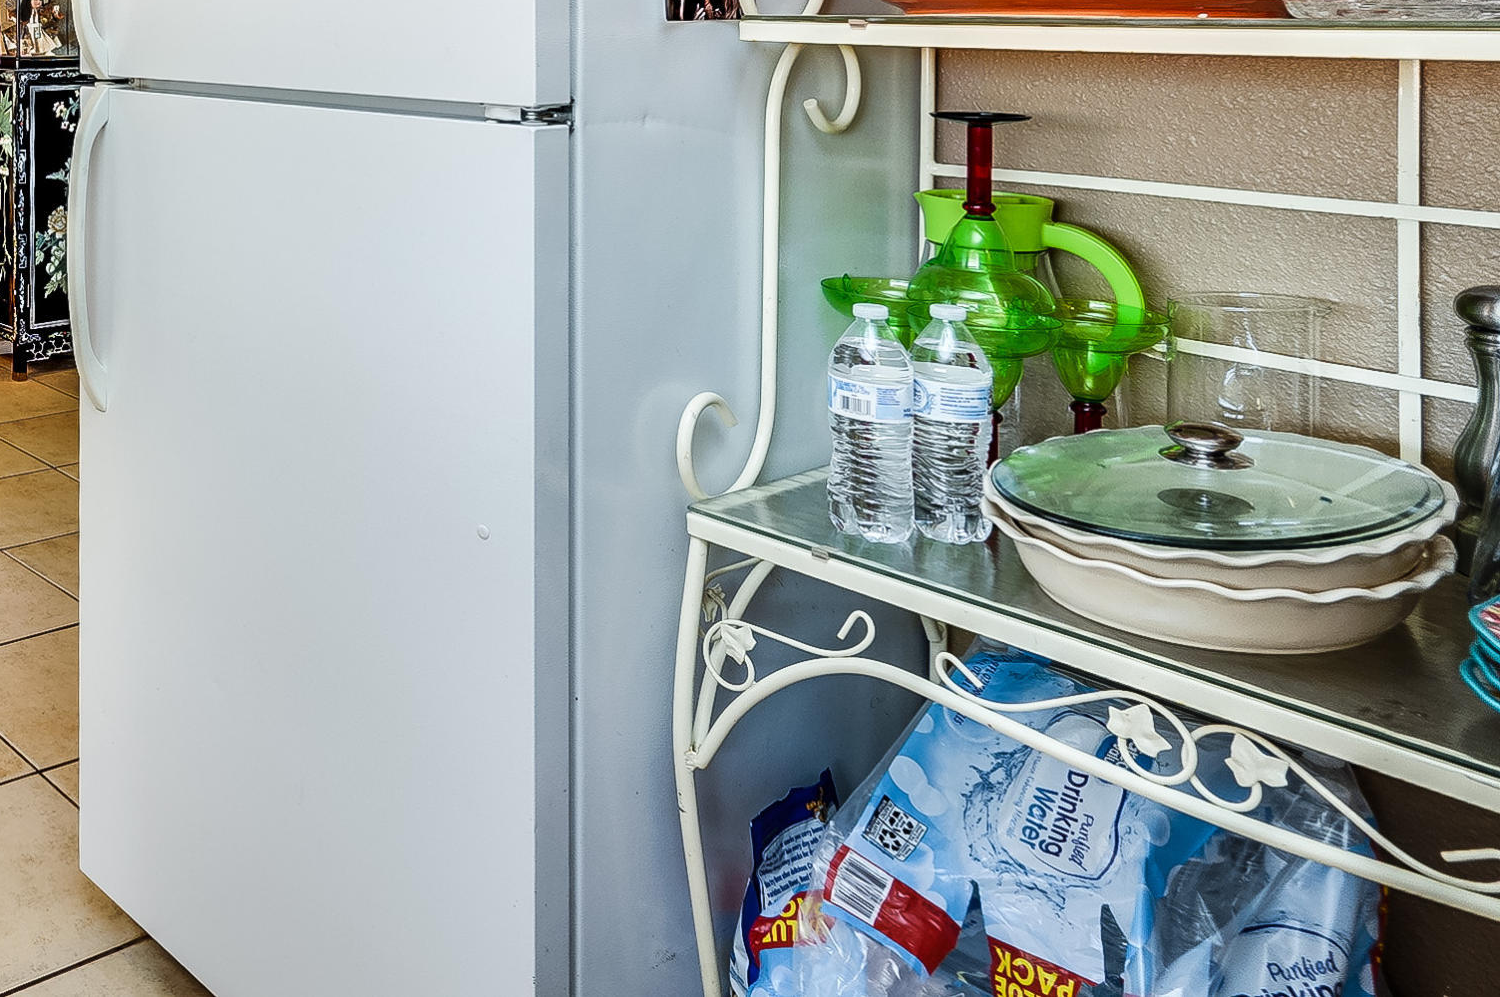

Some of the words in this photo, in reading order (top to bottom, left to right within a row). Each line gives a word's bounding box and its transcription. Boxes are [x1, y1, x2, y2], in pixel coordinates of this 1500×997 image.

[1019, 787, 1059, 850] Water
[1037, 769, 1089, 857] Drinking
[1070, 813, 1094, 871] Purified
[1266, 950, 1340, 981] Purified
